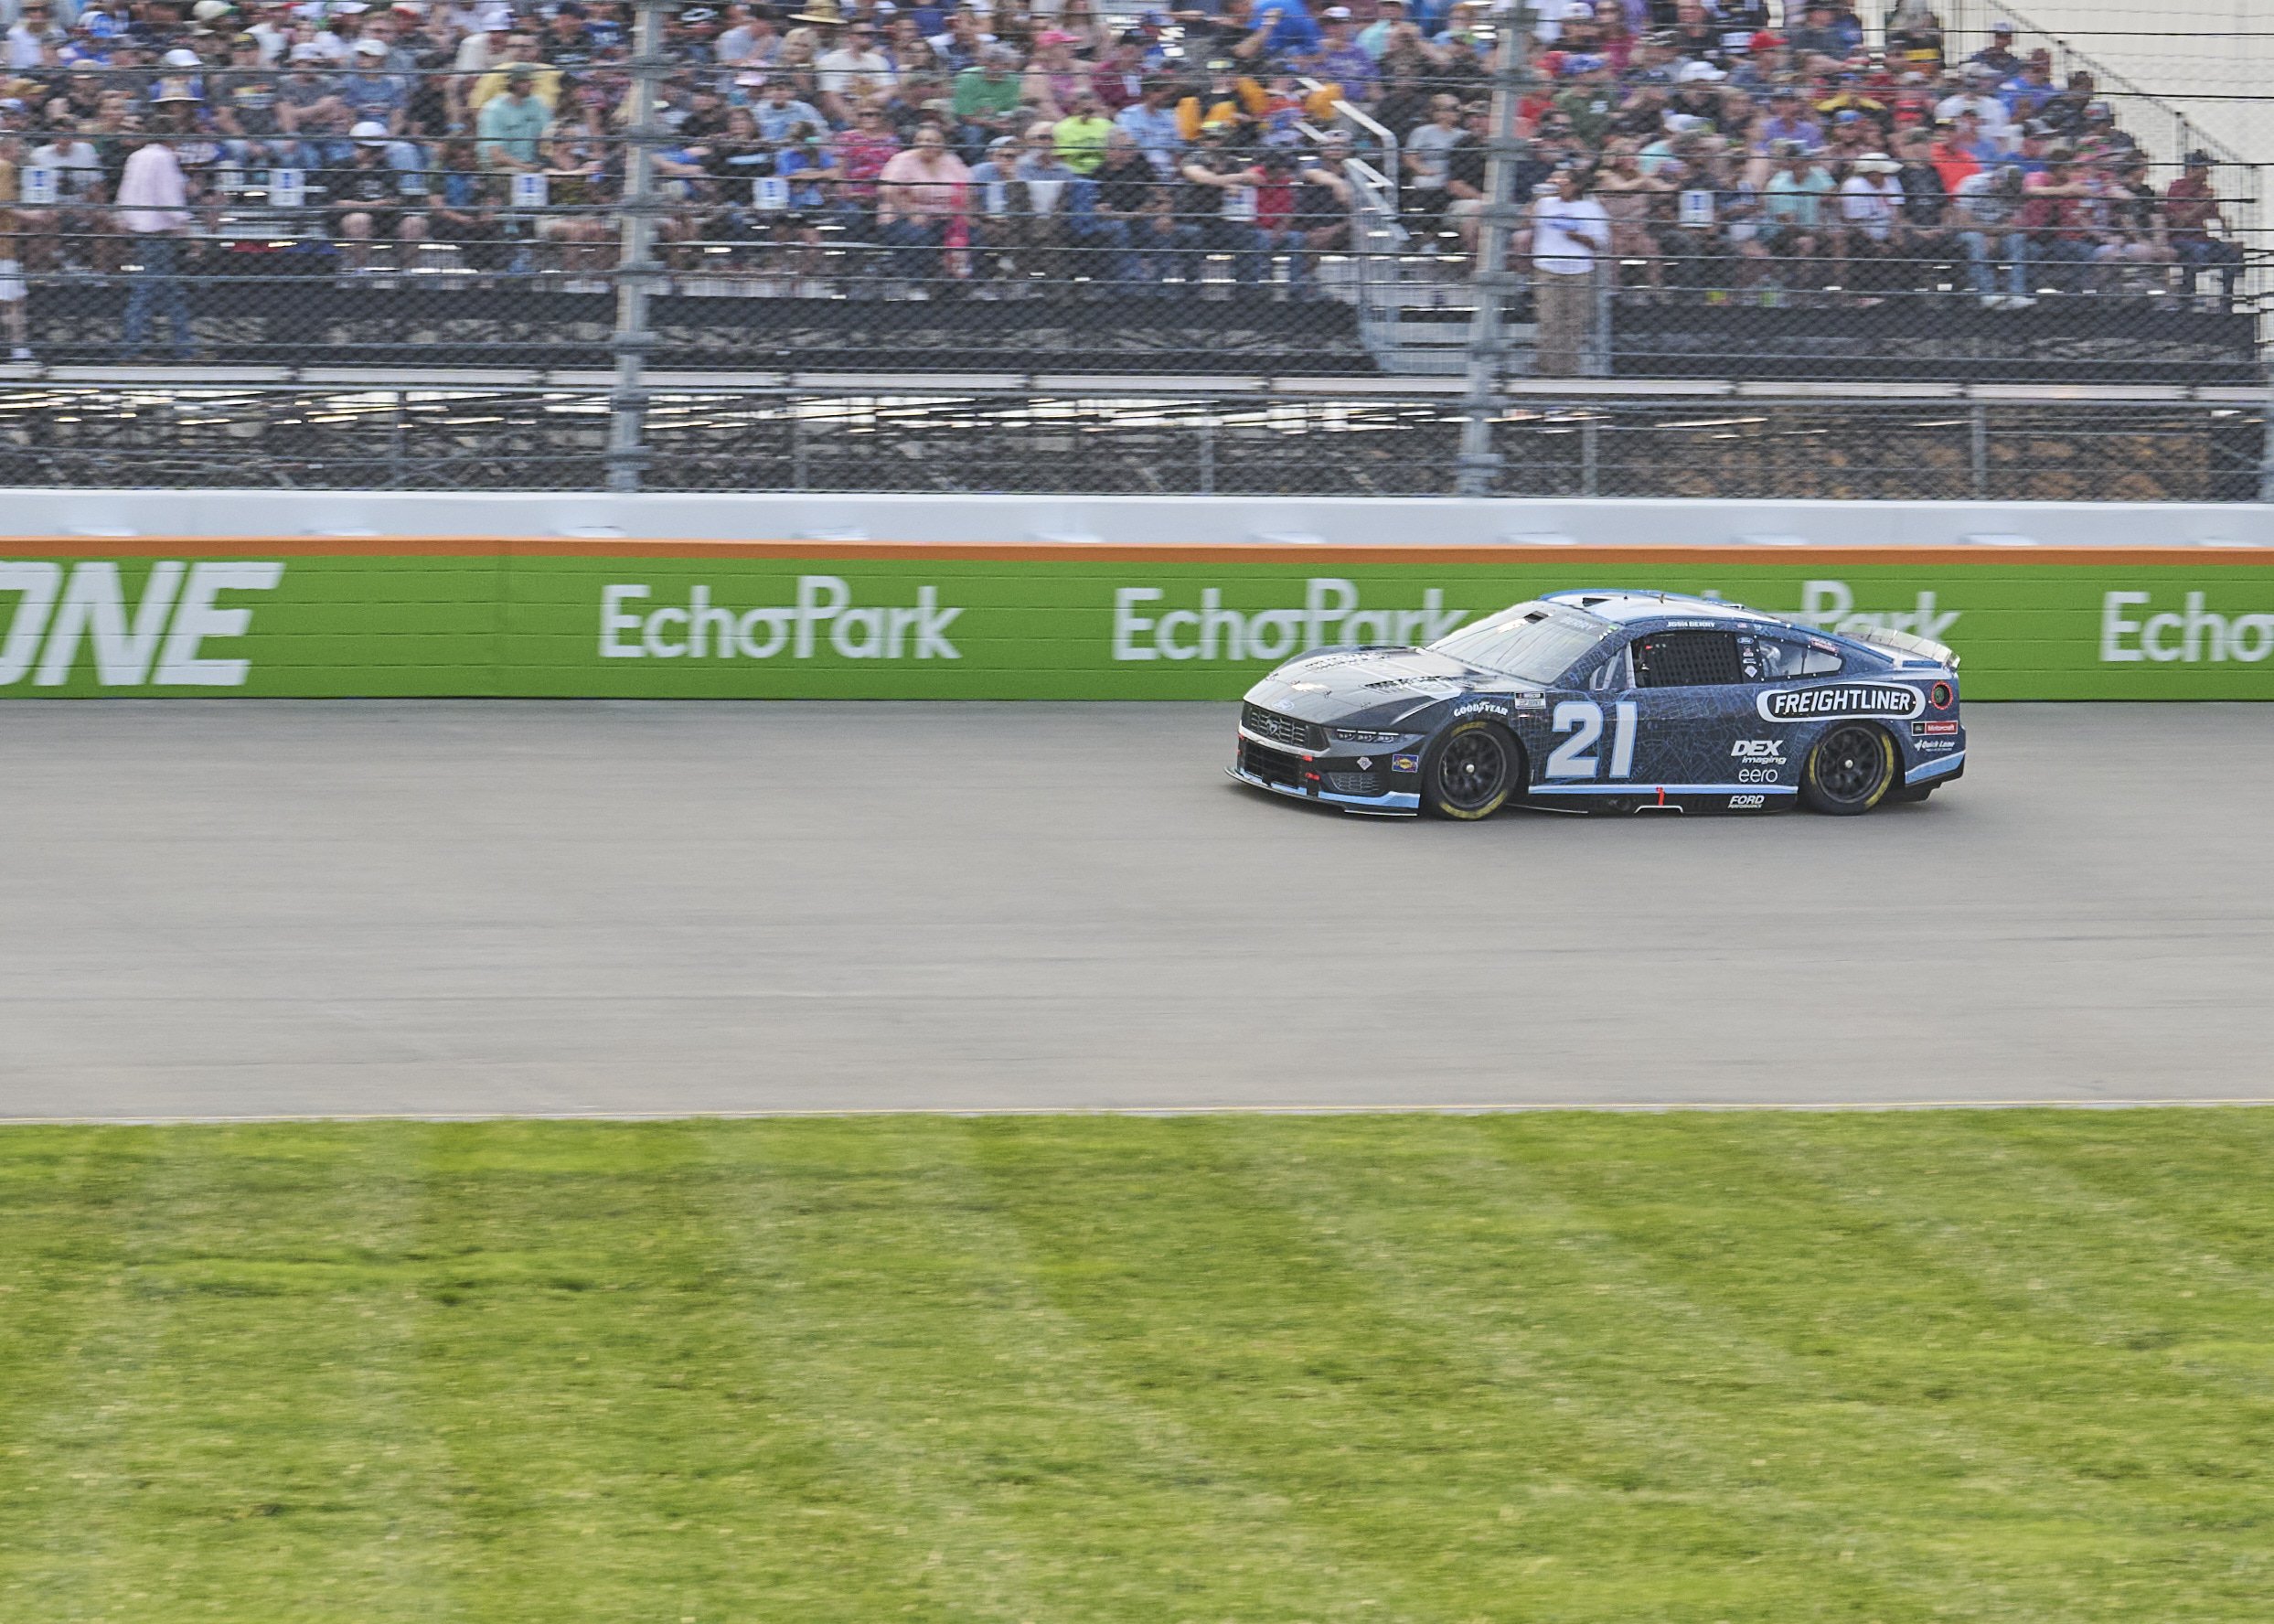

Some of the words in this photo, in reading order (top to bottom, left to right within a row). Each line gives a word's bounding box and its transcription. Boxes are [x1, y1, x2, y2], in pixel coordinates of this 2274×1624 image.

[599, 575, 966, 659] EchoPark
[1113, 578, 1473, 661] EchoPark
[1453, 700, 1509, 717] GOODYEAR
[1774, 689, 1912, 714] FREIGHTLINER
[1545, 700, 1639, 779] 21
[1730, 740, 1784, 757] DEX
[1741, 755, 1788, 765] imaging
[1738, 769, 1778, 783] eero
[1729, 795, 1765, 805] FORD
